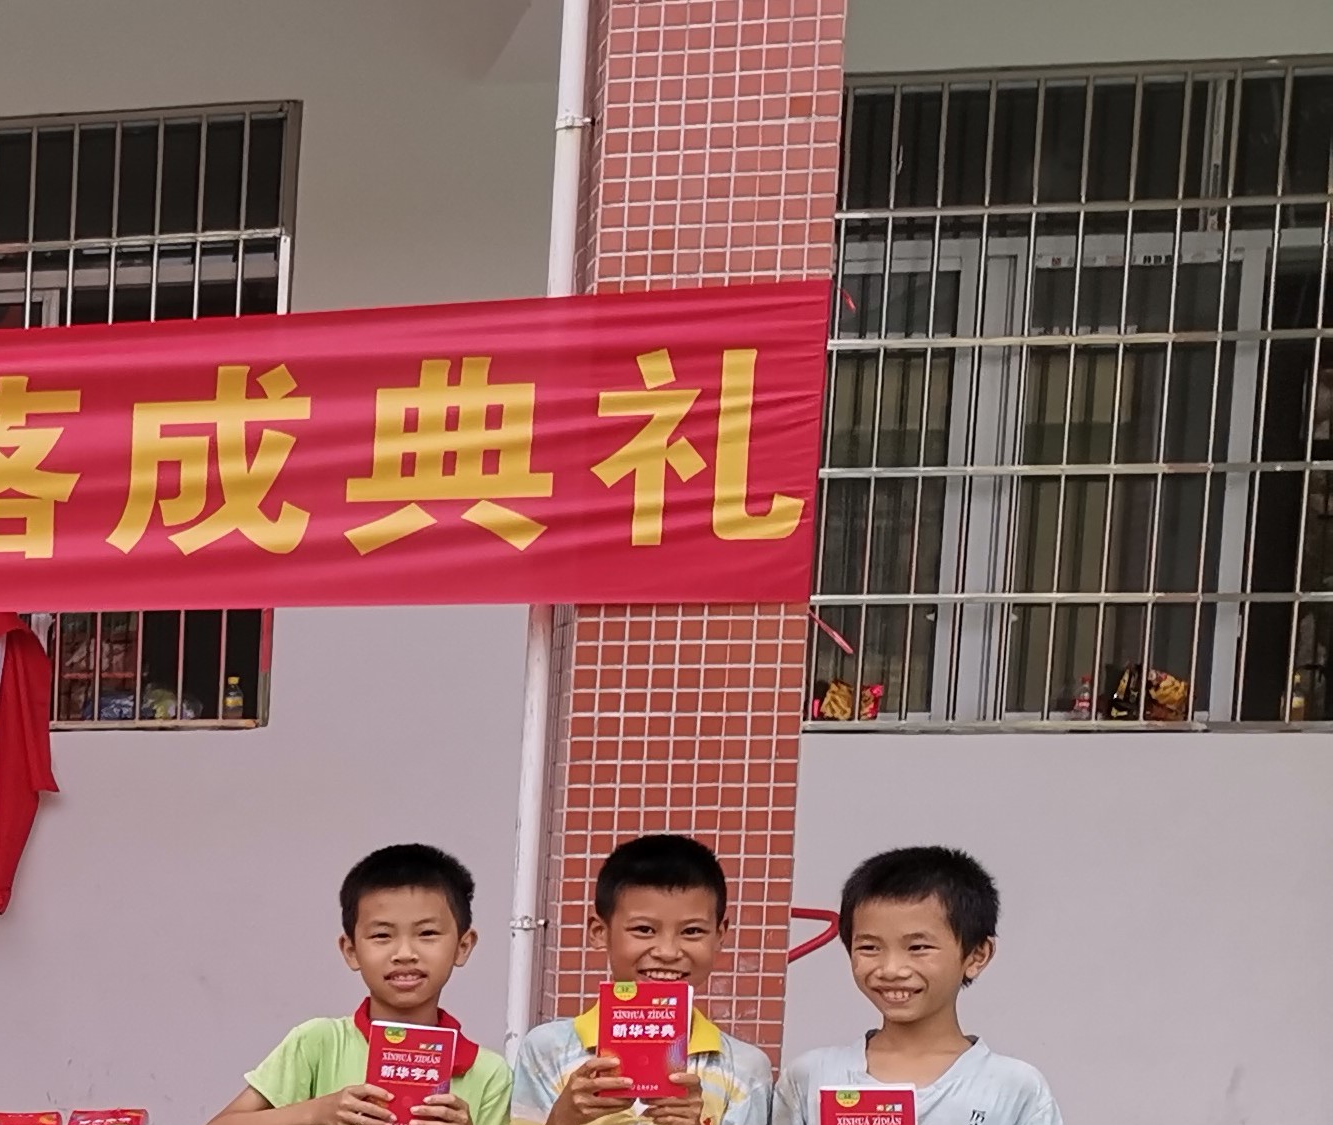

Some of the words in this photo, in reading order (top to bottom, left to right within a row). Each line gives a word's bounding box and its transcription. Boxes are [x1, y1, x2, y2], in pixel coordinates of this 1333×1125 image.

[612, 1023, 676, 1039] 新华字典
[380, 1065, 440, 1082] 新华字典
